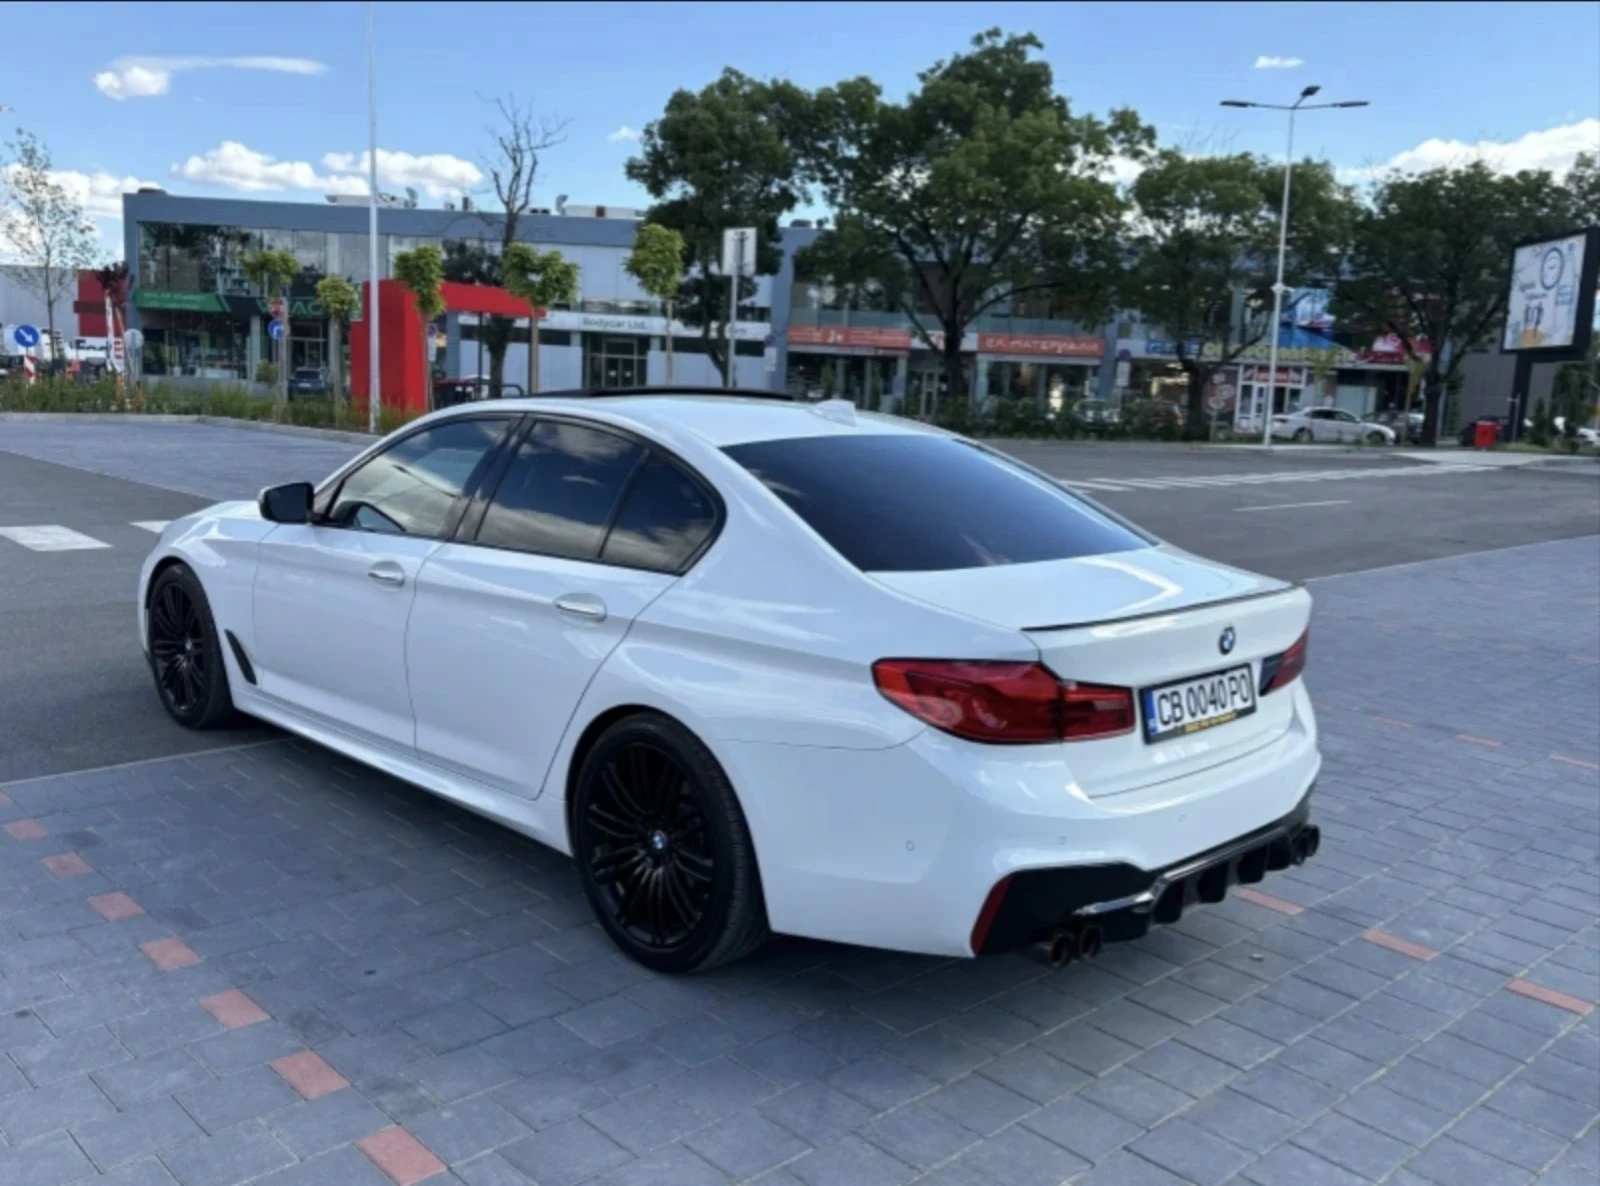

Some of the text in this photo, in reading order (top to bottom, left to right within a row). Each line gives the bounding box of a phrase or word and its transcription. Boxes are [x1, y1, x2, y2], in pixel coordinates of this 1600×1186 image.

[1158, 692, 1183, 725] CB
[1186, 679, 1227, 718] 0040
[1229, 674, 1249, 706] PO
